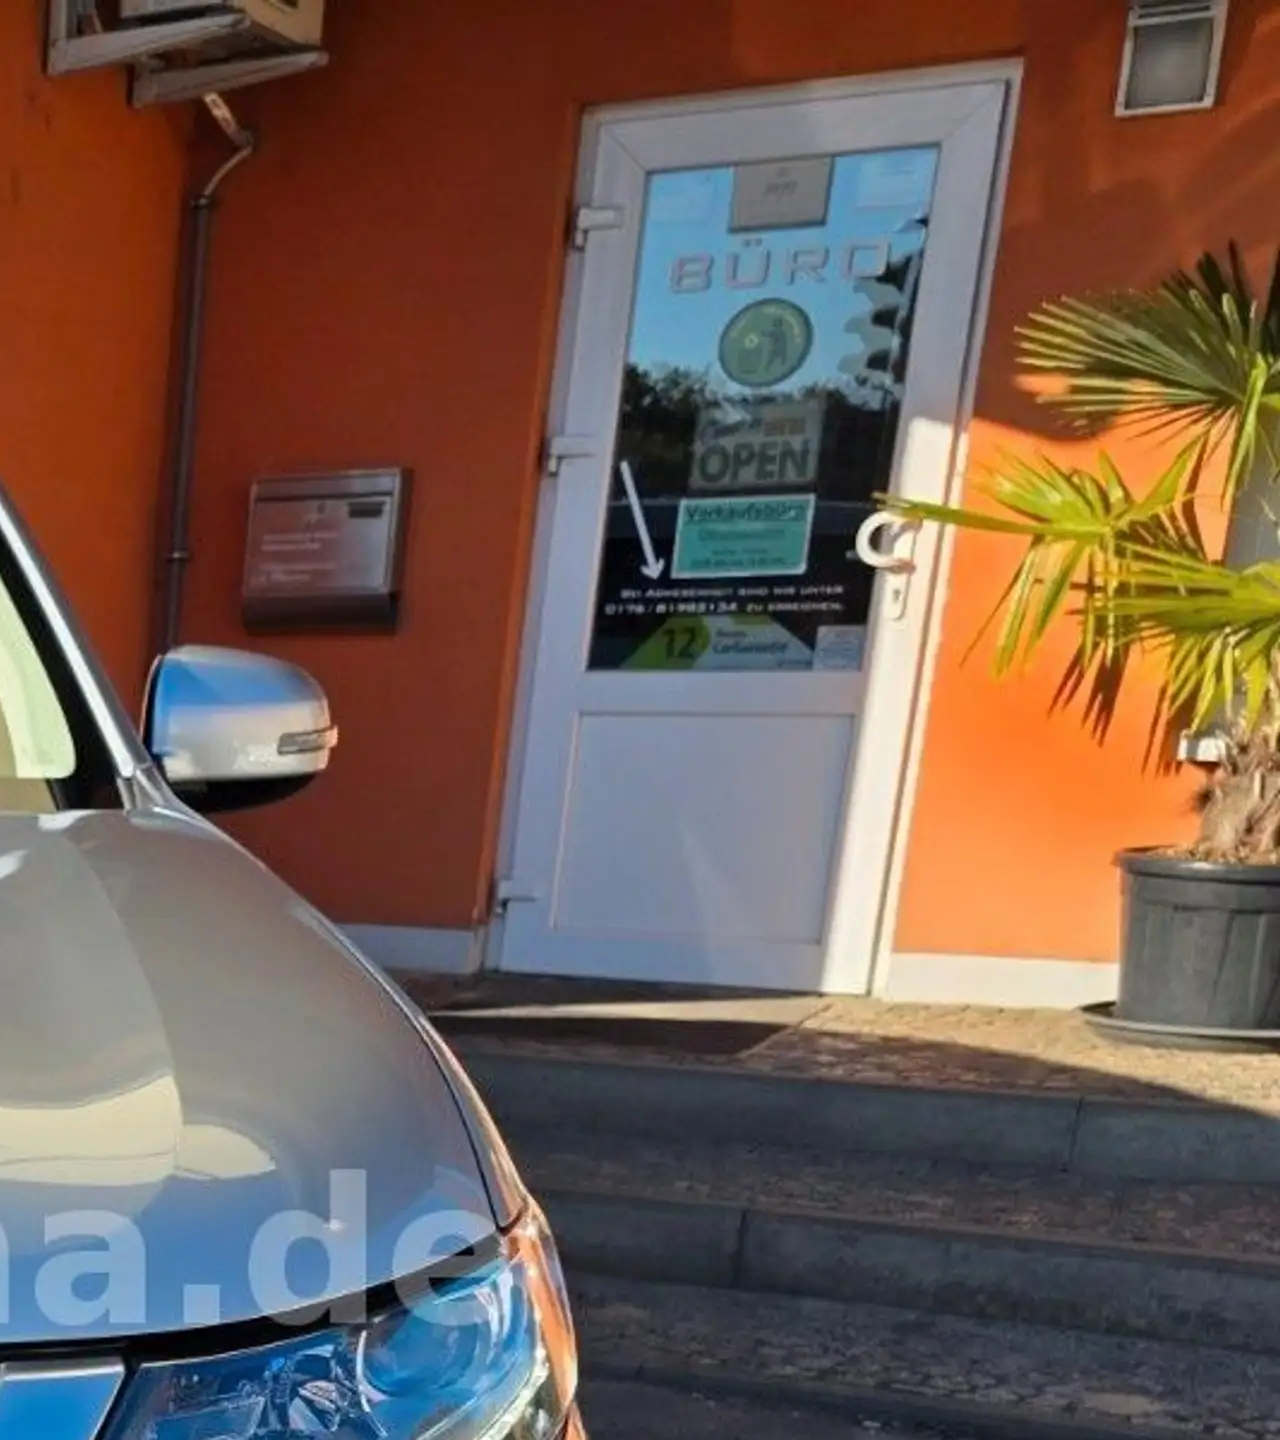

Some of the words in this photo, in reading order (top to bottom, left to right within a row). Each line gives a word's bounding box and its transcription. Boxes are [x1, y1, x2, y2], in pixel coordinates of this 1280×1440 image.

[669, 237, 891, 293] BÜRO
[698, 438, 813, 484] OPEN
[663, 627, 696, 659] 12
